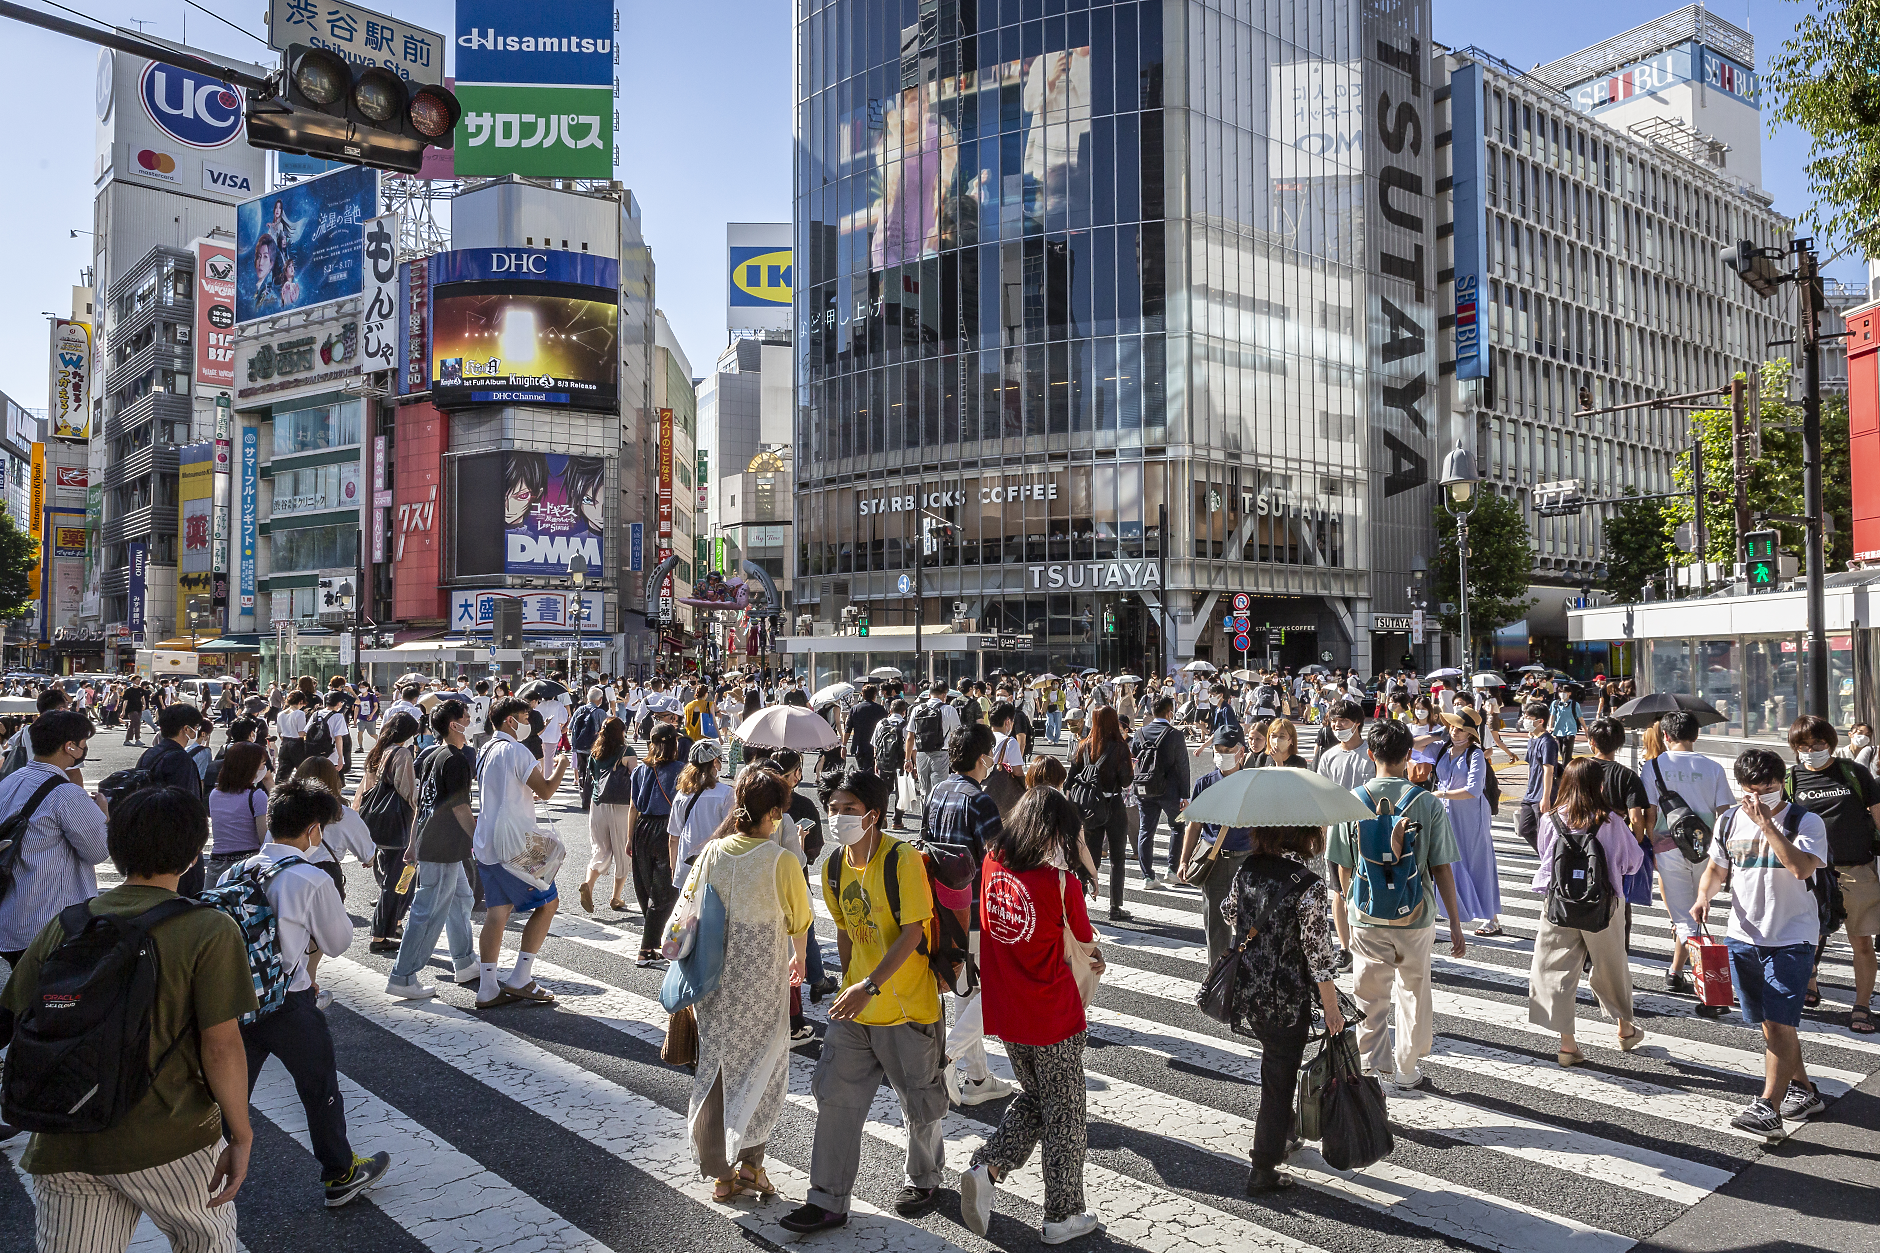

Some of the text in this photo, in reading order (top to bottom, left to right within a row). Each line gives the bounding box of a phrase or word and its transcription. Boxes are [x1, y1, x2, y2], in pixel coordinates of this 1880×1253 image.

[285, 0, 432, 68] 渋谷駅前
[458, 27, 611, 54] Hisamitsu
[1576, 55, 1676, 115] SEIBU
[1704, 53, 1755, 104] SEIBU
[464, 110, 604, 150] サロンパス
[138, 168, 174, 181] mastercard
[205, 167, 251, 192] VISA
[490, 252, 547, 274] DHC
[745, 264, 793, 288] IK
[1376, 36, 1429, 499] TSUTAYA
[364, 219, 395, 367] もんじゃ
[1455, 273, 1479, 361] SEIBU
[492, 392, 546, 401] DHC Channel
[557, 380, 568, 388] 8/3
[570, 381, 598, 391] Release
[661, 411, 672, 483] クスリのことなら
[243, 447, 256, 546] サマーフルーツギフト
[529, 501, 578, 518] コードギアス
[660, 488, 672, 532] 三千里
[859, 483, 1058, 516] STARBUCKS COFFEE
[1241, 491, 1340, 524] TSUTAYA
[186, 513, 210, 550] 薬
[373, 509, 382, 561] もんじゃ焼
[135, 550, 143, 577] MIZUHO
[507, 533, 602, 567] DMM
[1028, 561, 1162, 589] TSUTAYA
[1374, 615, 1411, 629] TSUTAYA
[1807, 785, 1852, 800] Columbia
